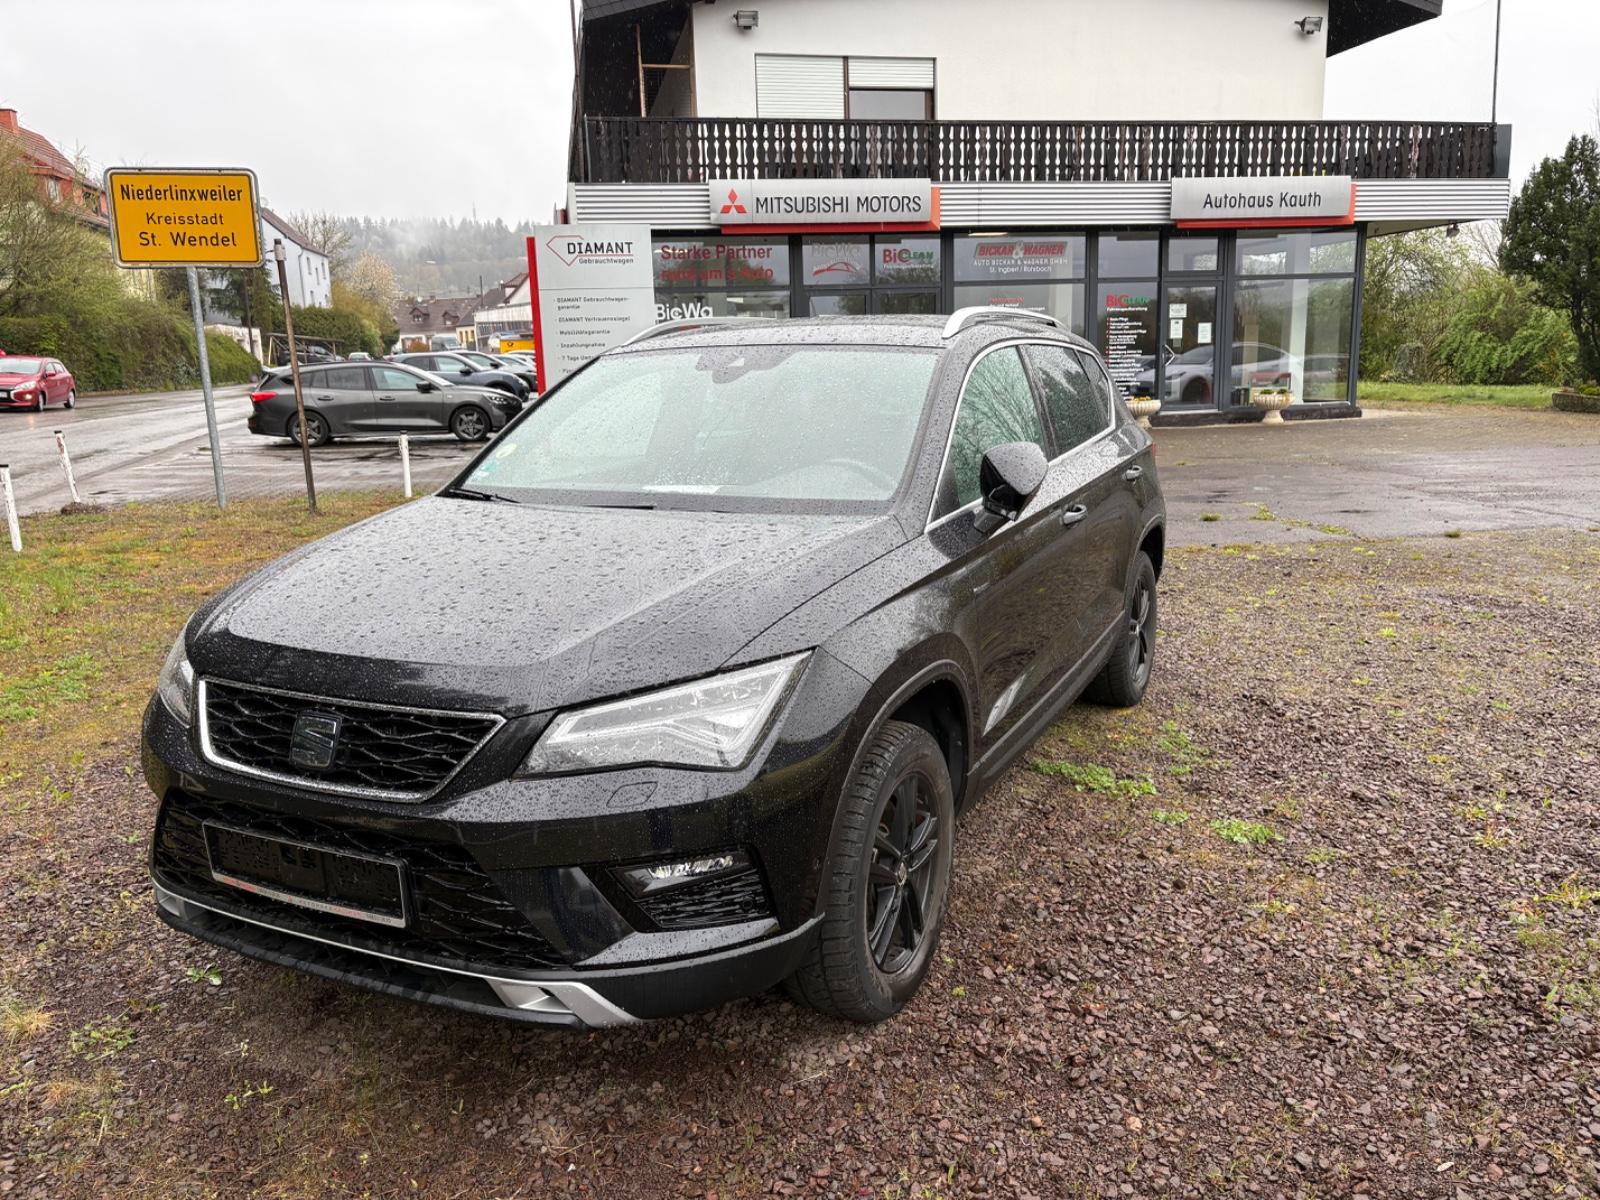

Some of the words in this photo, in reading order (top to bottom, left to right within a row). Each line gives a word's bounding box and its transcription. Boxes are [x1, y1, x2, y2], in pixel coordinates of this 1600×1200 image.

[120, 184, 243, 201] Niederlinxweiler
[1203, 193, 1274, 209] Autohaus
[1279, 191, 1322, 208] Kauth
[755, 196, 849, 214] MITSUBISHI
[856, 195, 922, 213] MOTORS
[146, 211, 224, 225] Kreisstadt
[139, 231, 161, 247] St.
[170, 231, 237, 247] Wendel
[567, 242, 633, 255] DIAMANT
[661, 245, 711, 260] Starke
[715, 244, 773, 260] Partner
[977, 245, 1014, 256] BICKAR
[1012, 241, 1024, 259] &
[1023, 244, 1065, 256] WAGNER
